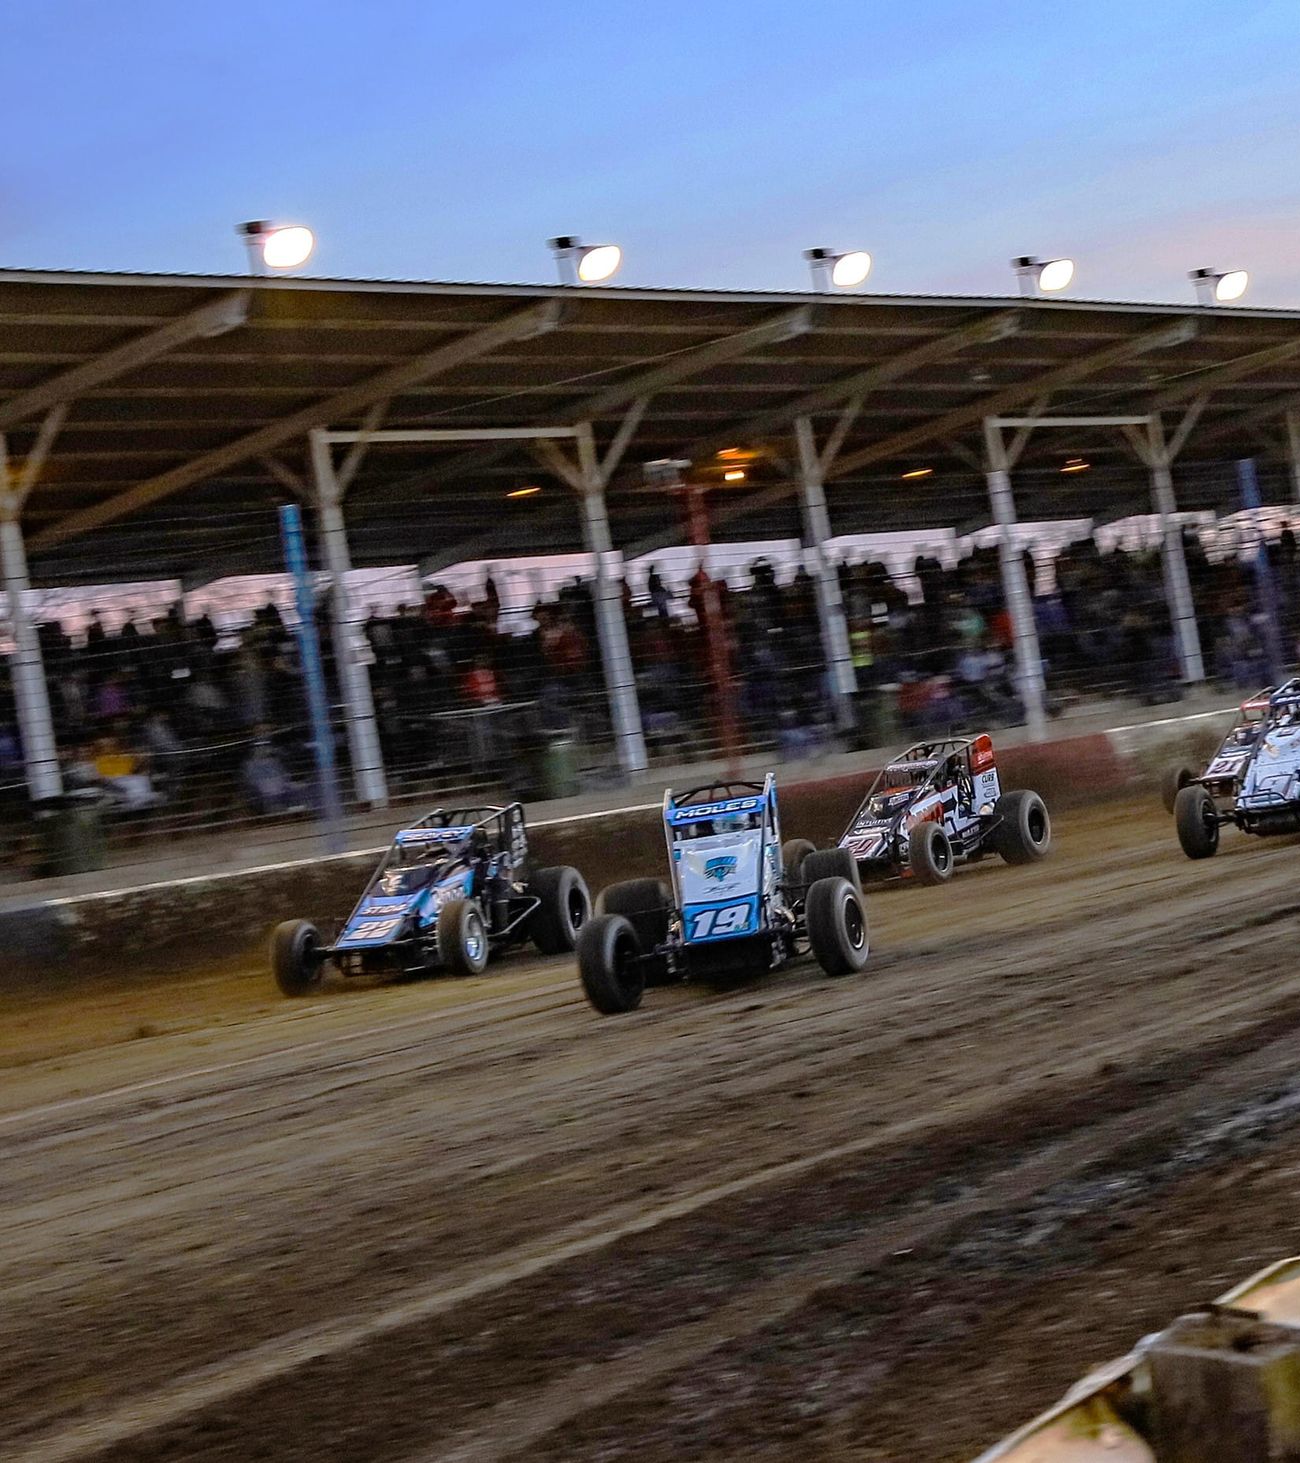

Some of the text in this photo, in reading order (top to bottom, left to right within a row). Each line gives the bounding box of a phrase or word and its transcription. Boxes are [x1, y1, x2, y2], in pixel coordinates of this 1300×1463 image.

[1213, 759, 1240, 773] 21
[981, 773, 995, 784] CURB
[675, 799, 758, 820] MOLES
[345, 918, 401, 941] 22
[693, 903, 751, 939] 19
